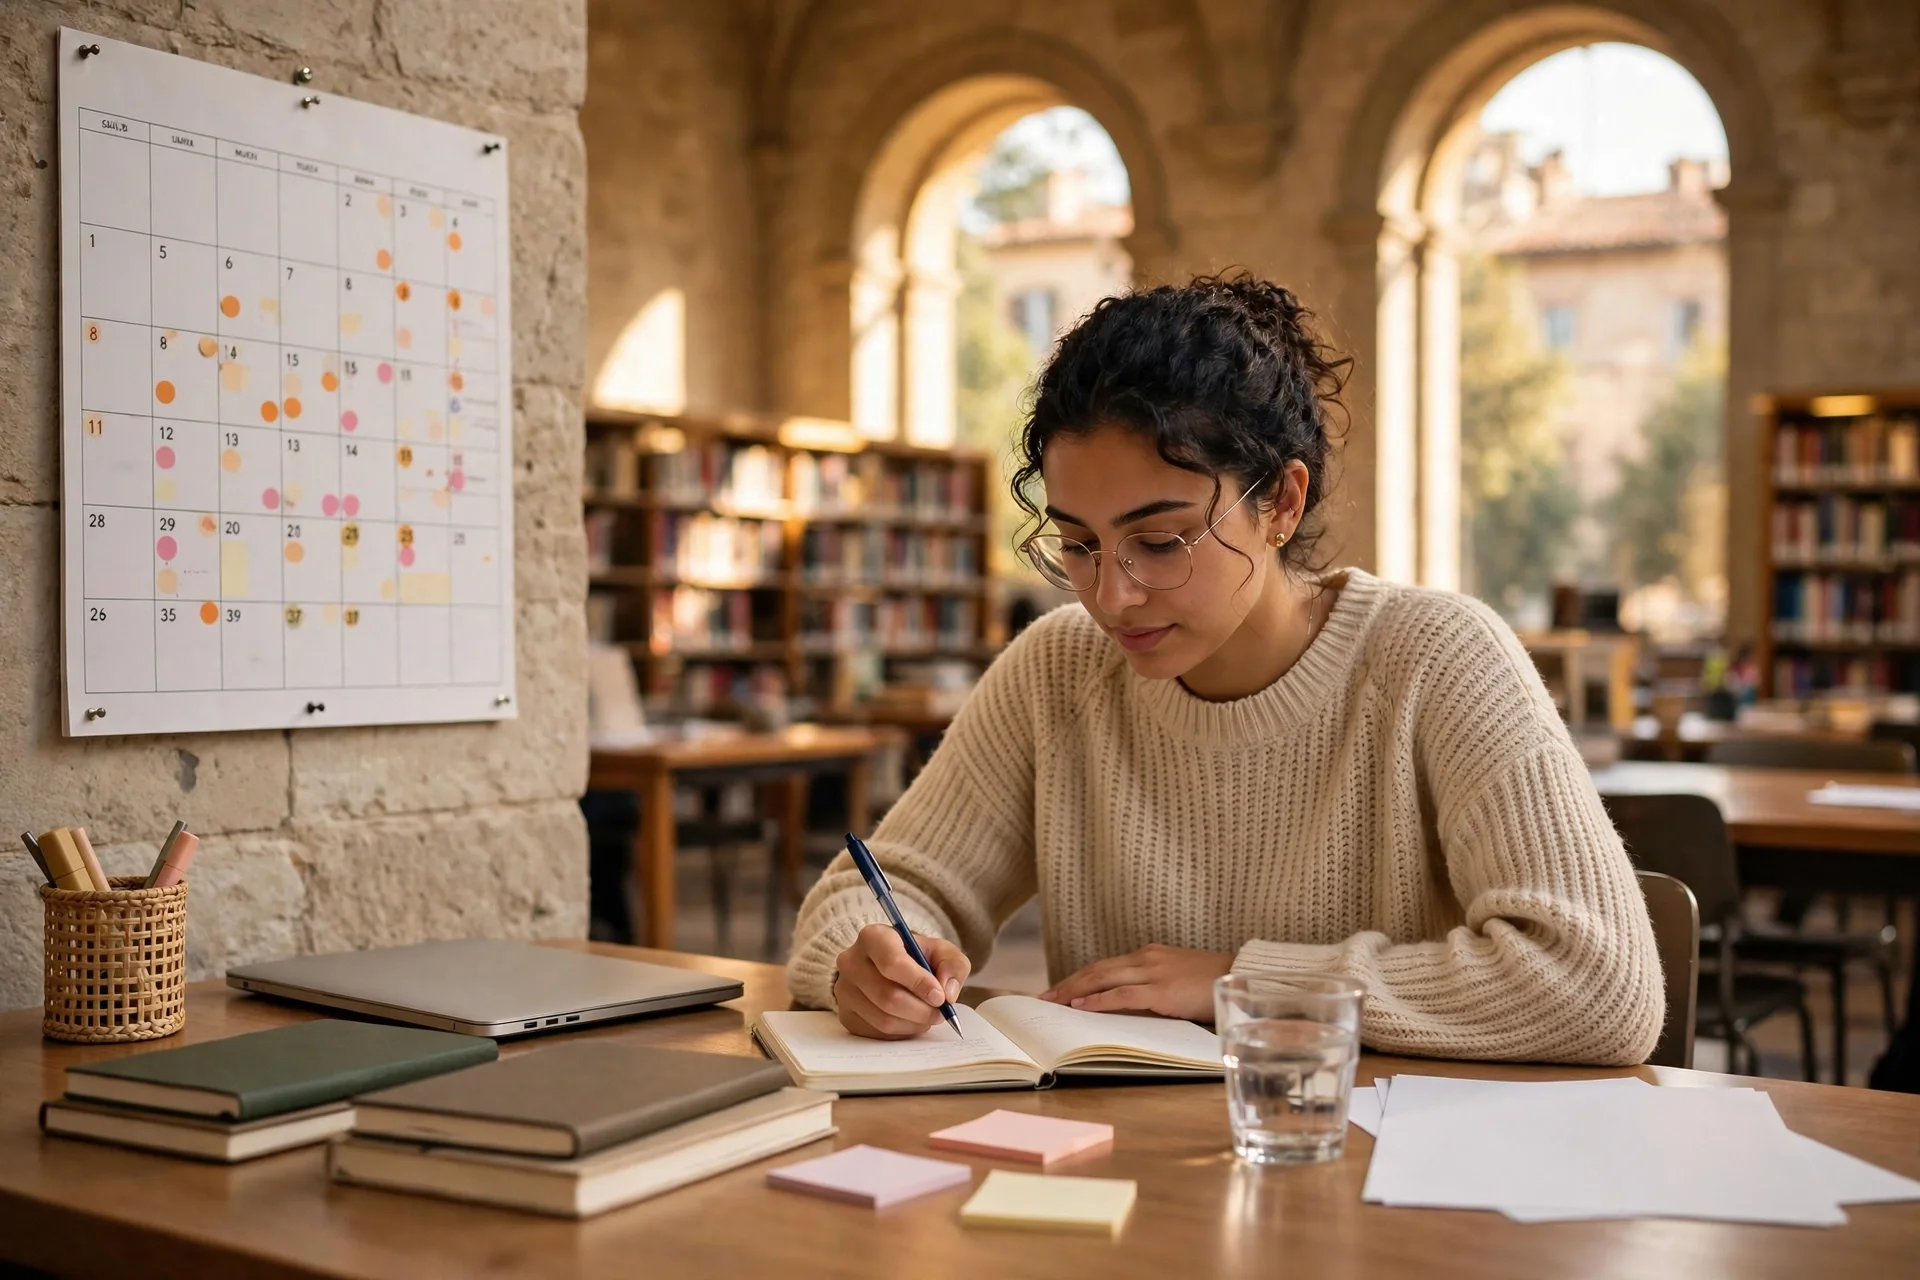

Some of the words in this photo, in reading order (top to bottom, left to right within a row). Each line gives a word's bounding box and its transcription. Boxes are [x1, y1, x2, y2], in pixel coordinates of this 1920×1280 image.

[345, 194, 352, 207] 2
[90, 233, 95, 248] 1
[159, 245, 167, 260] 5
[225, 257, 233, 270] 6
[286, 267, 294, 280] 7
[345, 277, 352, 291] 8
[89, 326, 98, 341] 8
[159, 336, 168, 350] 8
[224, 345, 237, 360] 14
[286, 353, 299, 367] 15
[88, 419, 103, 435] 11
[159, 426, 174, 441] 12
[225, 432, 239, 447] 13
[287, 439, 300, 452] 13
[346, 444, 358, 457] 14
[89, 513, 106, 528] 28
[159, 517, 176, 532] 29
[225, 521, 240, 536] 20
[90, 607, 107, 622] 26
[160, 608, 177, 622] 35
[226, 608, 241, 623] 39
[287, 609, 302, 624] 37
